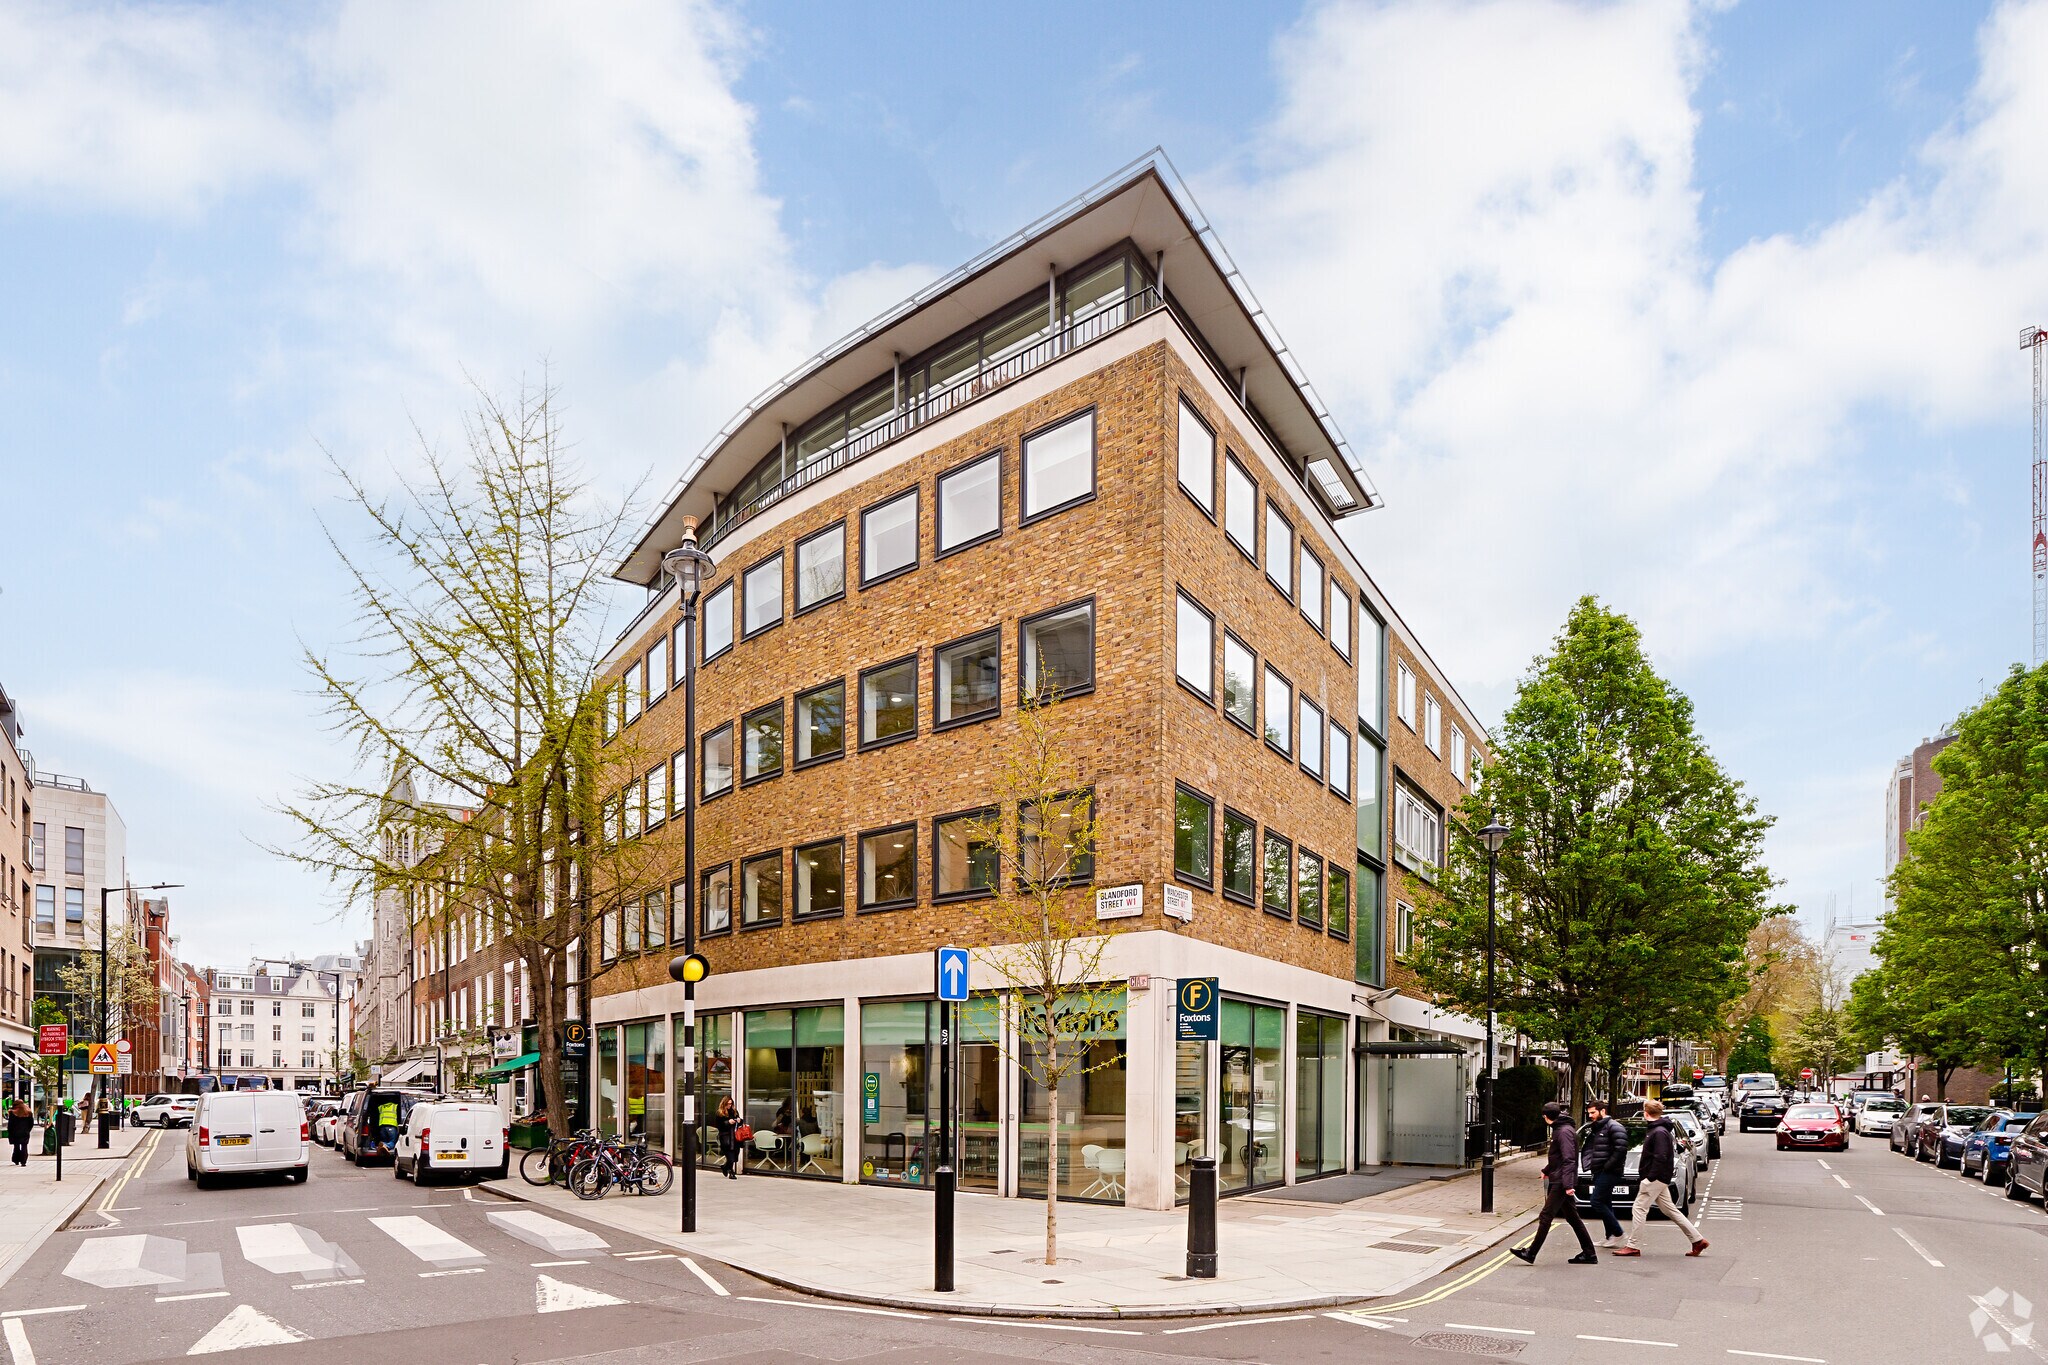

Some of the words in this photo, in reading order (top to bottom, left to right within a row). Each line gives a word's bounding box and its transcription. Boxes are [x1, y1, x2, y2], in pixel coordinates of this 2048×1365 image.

[1100, 899, 1123, 909] STREET
[1126, 898, 1136, 906] W1
[1179, 1013, 1211, 1022] Foxtons
